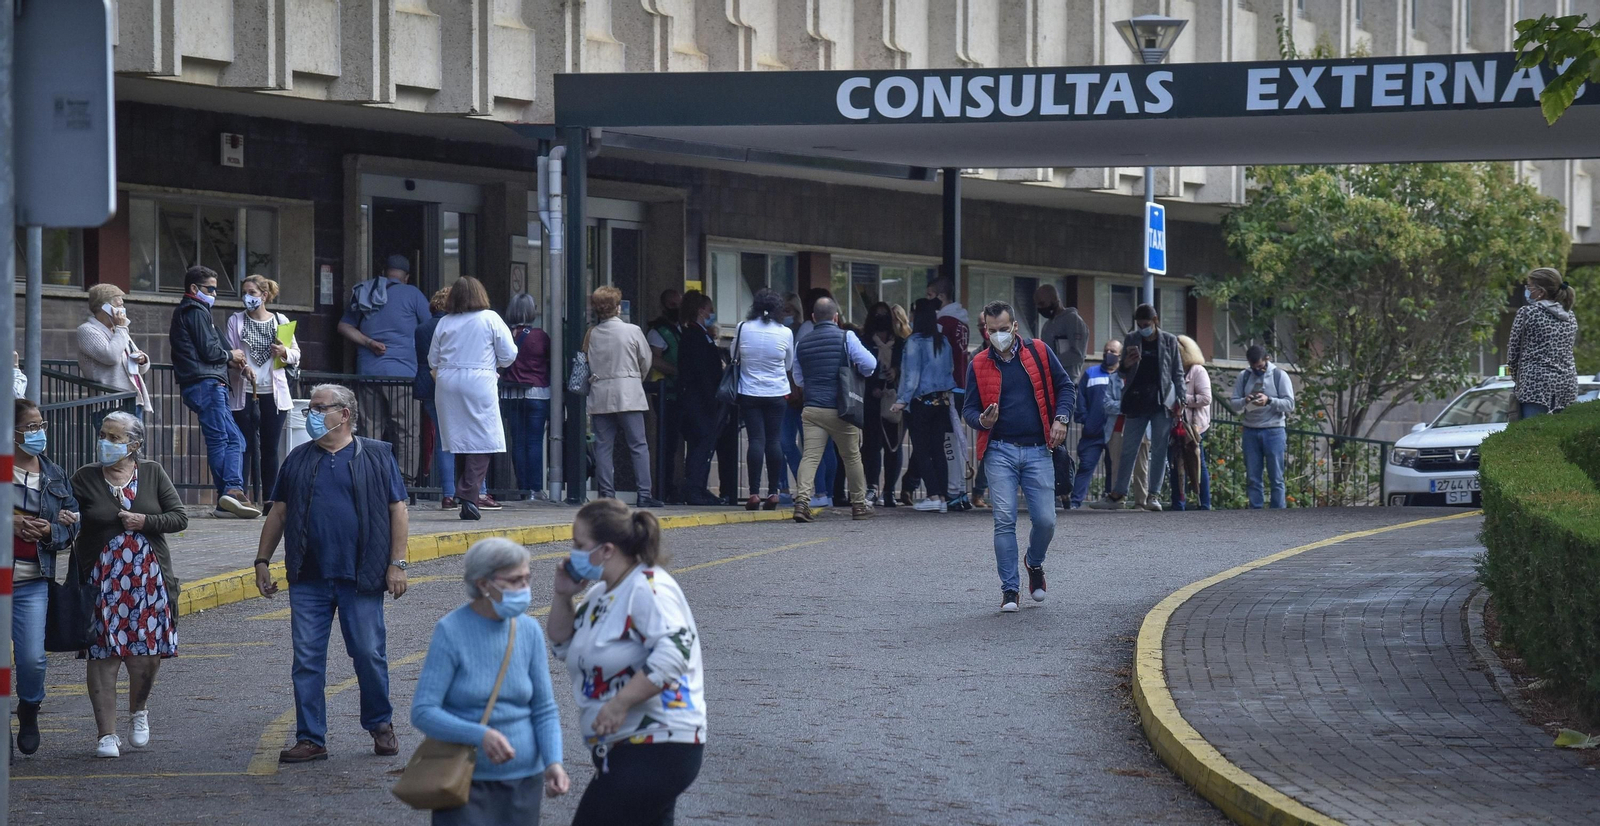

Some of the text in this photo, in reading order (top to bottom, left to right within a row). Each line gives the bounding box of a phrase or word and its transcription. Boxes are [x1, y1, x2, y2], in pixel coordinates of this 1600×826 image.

[836, 71, 1174, 119] CONSULTAS
[1149, 228, 1164, 251] TAXI
[1437, 479, 1480, 491] 2744 KB
[1450, 491, 1468, 502] SP
